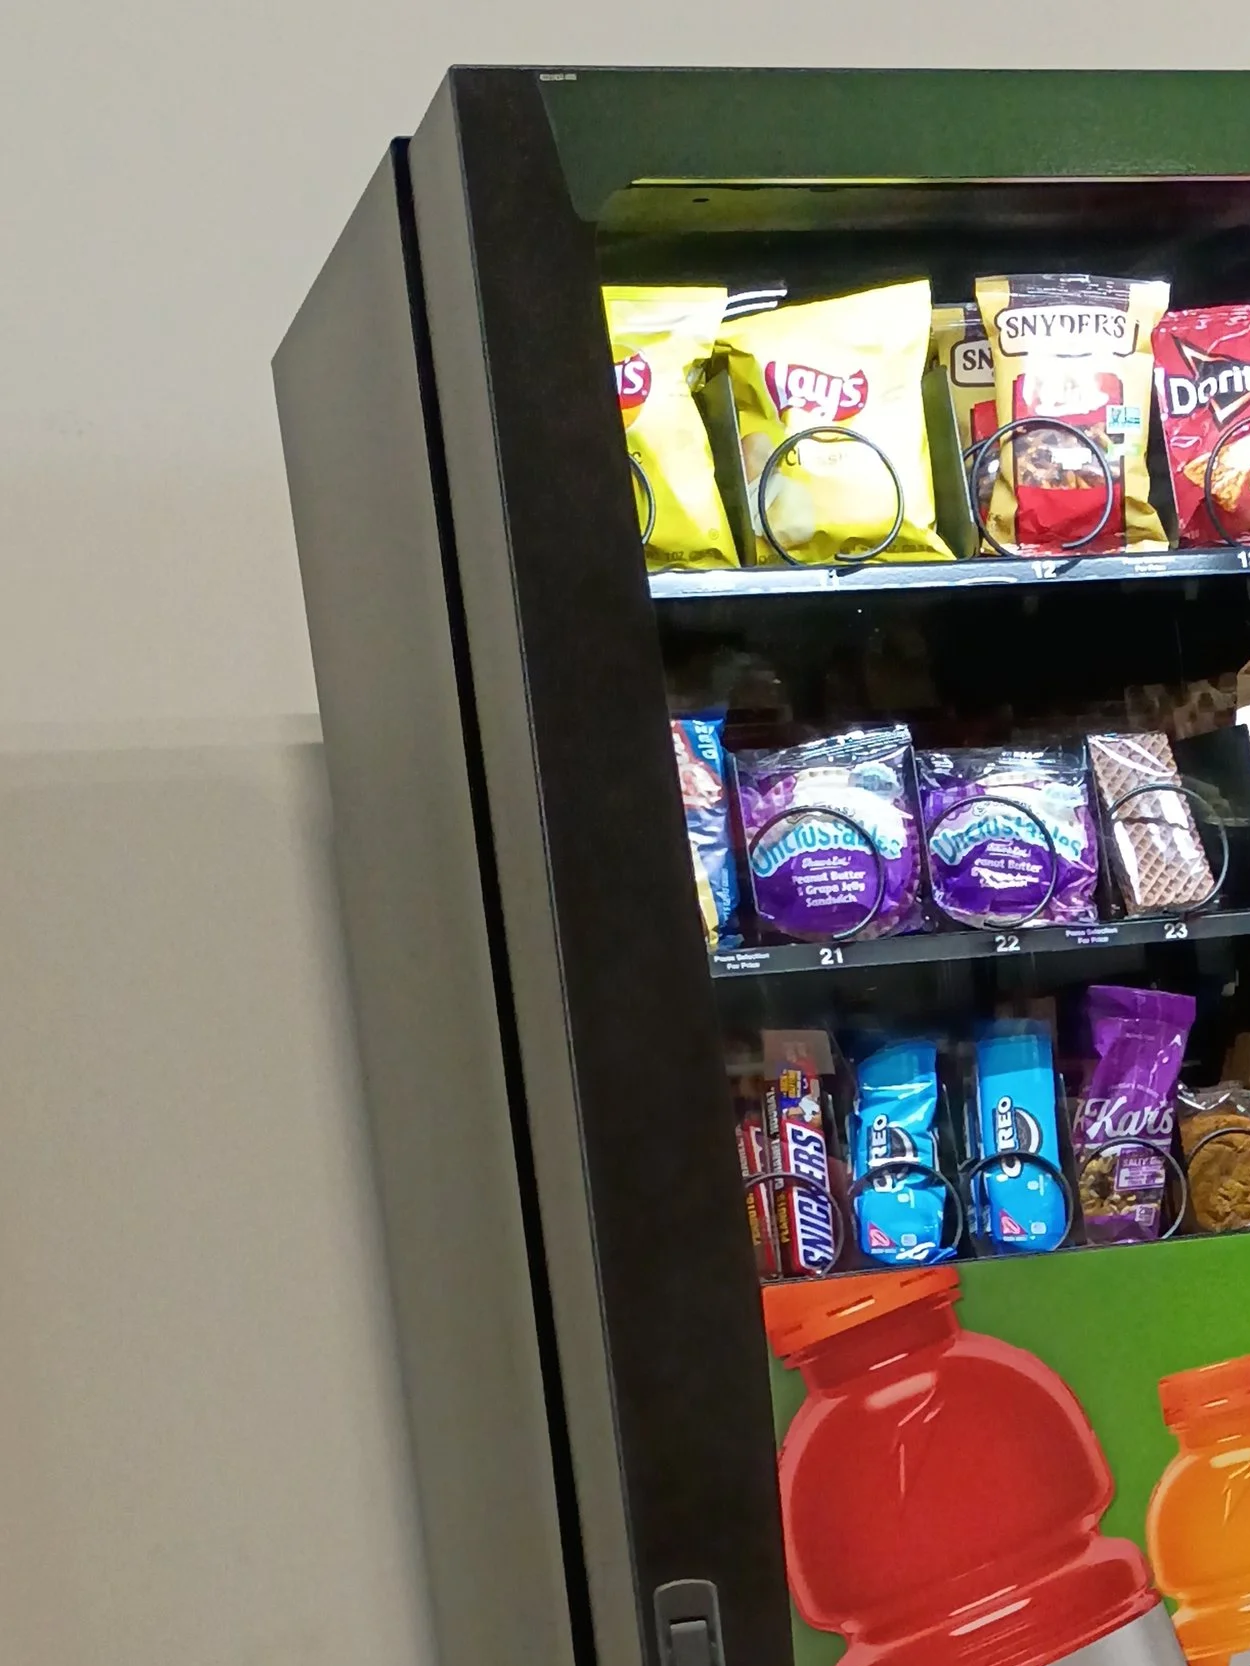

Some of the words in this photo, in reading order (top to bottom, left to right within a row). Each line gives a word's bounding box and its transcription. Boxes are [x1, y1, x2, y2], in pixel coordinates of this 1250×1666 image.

[1031, 562, 1056, 579] 12
[1007, 859, 1043, 874] Butter
[831, 869, 866, 881] Butter
[806, 885, 840, 899] Grape
[1164, 923, 1189, 940] 23
[995, 936, 1021, 952] 22
[819, 948, 844, 966] 21
[1084, 1095, 1174, 1140] Kar's
